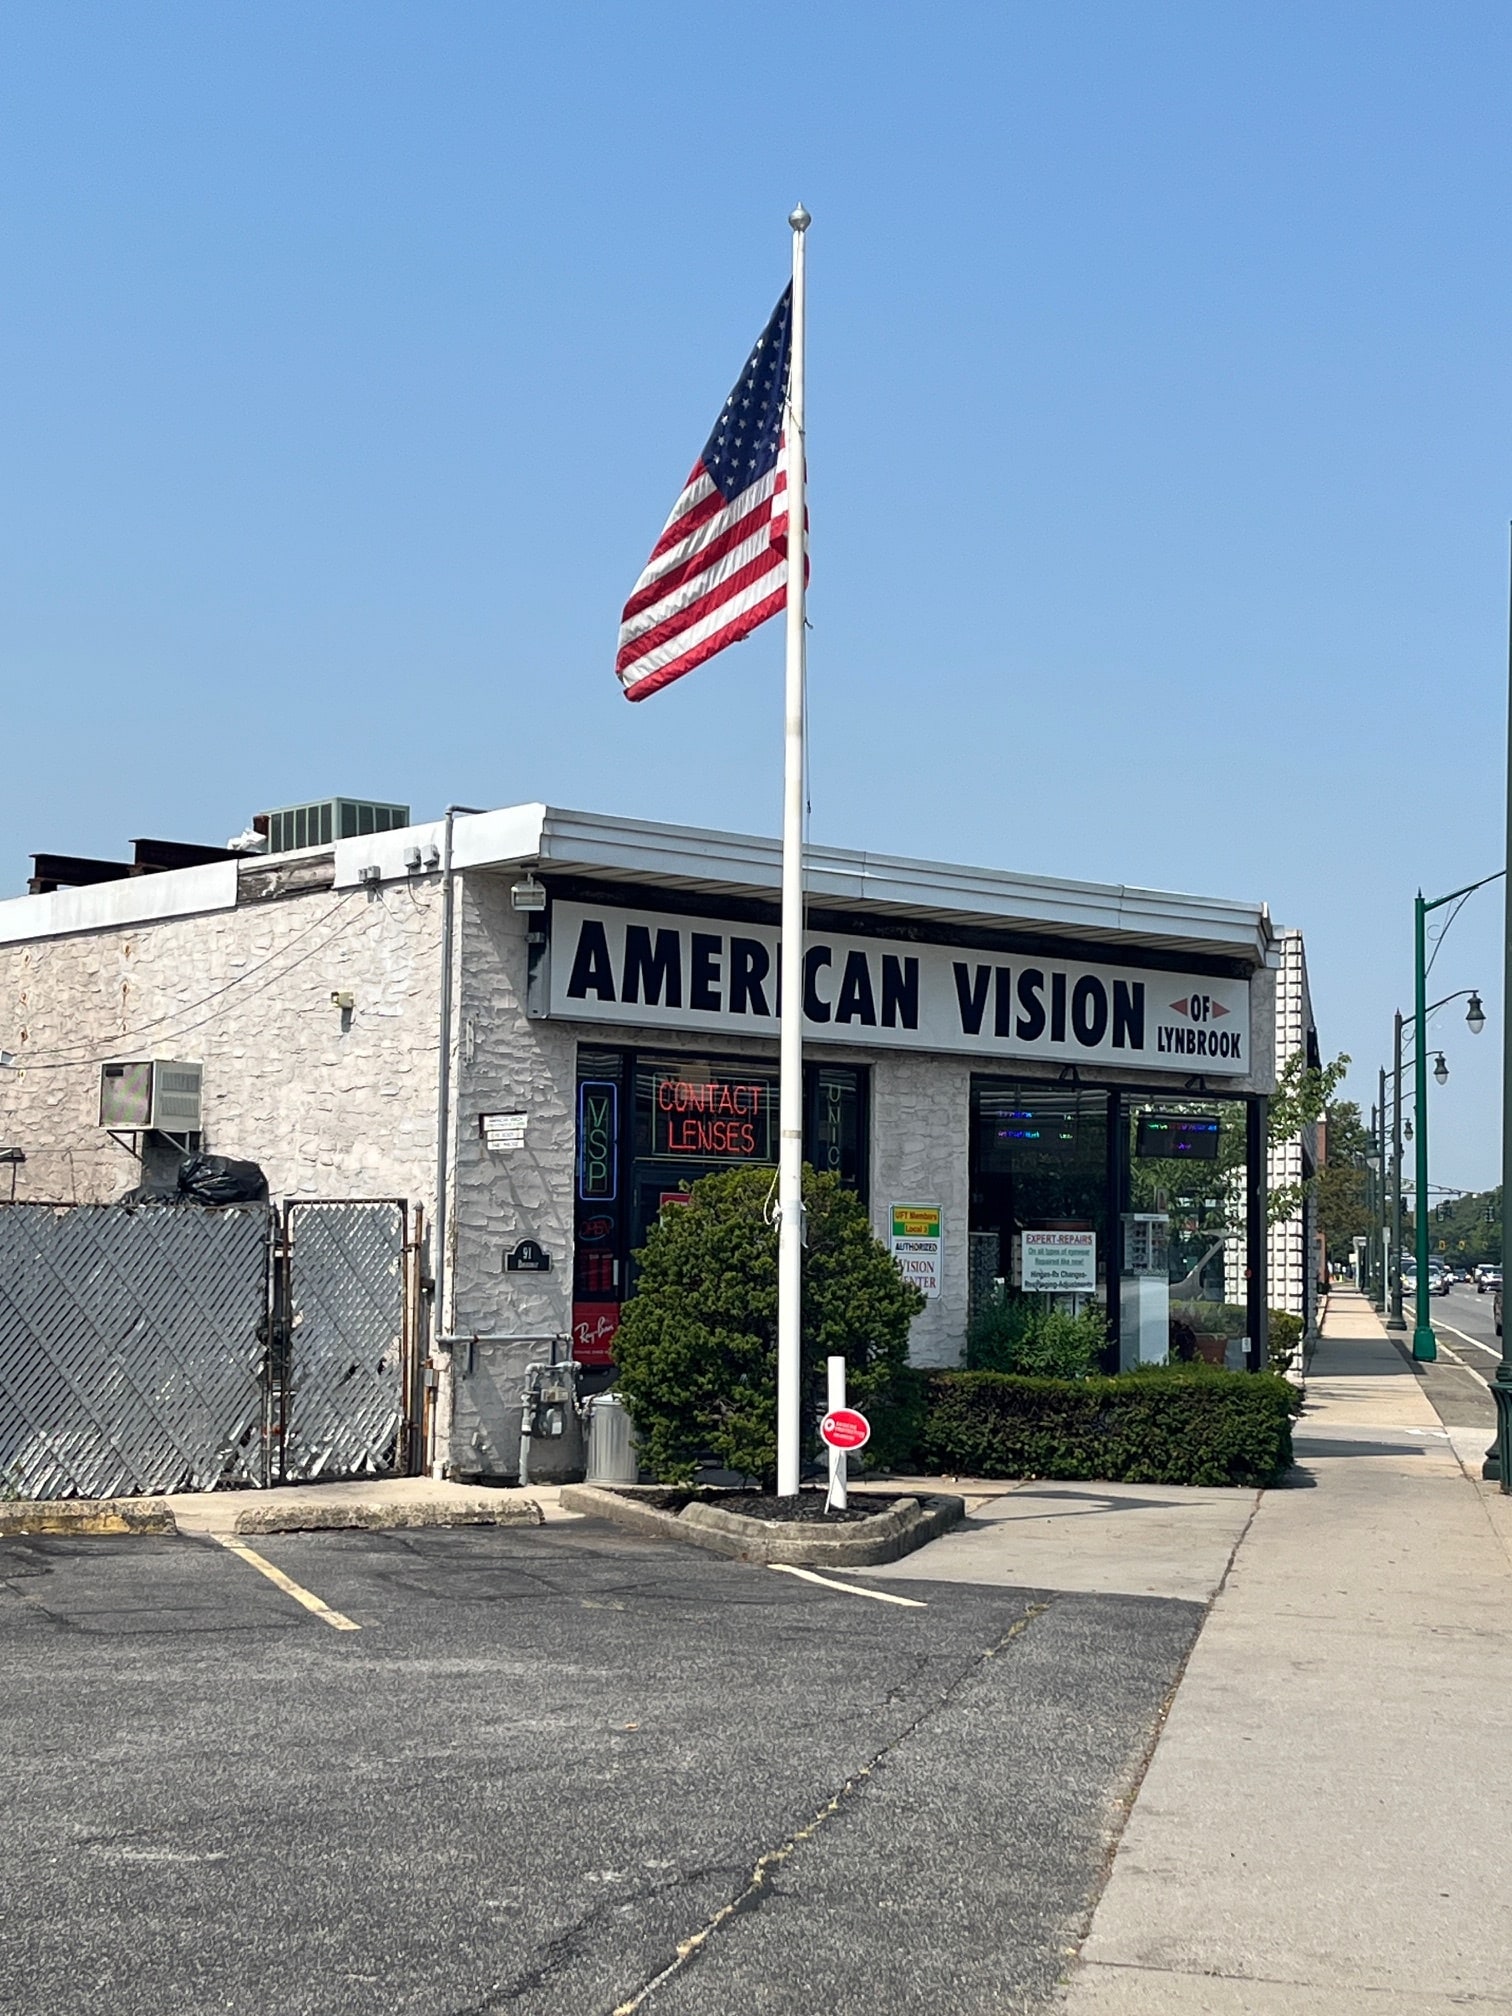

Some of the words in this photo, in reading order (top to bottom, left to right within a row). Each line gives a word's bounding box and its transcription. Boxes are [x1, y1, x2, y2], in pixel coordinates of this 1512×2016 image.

[952, 961, 1145, 1051] VISION
[1190, 993, 1210, 1022] OF
[1157, 1026, 1242, 1059] LYNBROOK
[659, 1081, 763, 1115] CONTACT
[588, 1098, 608, 1190] VSP
[668, 1120, 756, 1153] LENSES
[905, 1224, 923, 1233] Local
[1026, 1233, 1093, 1244] EXPERT-REPAIRS
[522, 1246, 532, 1260] 91
[895, 1243, 938, 1252] AUTHORIZED
[899, 1259, 936, 1274] VISION
[903, 1276, 937, 1289] ENTER
